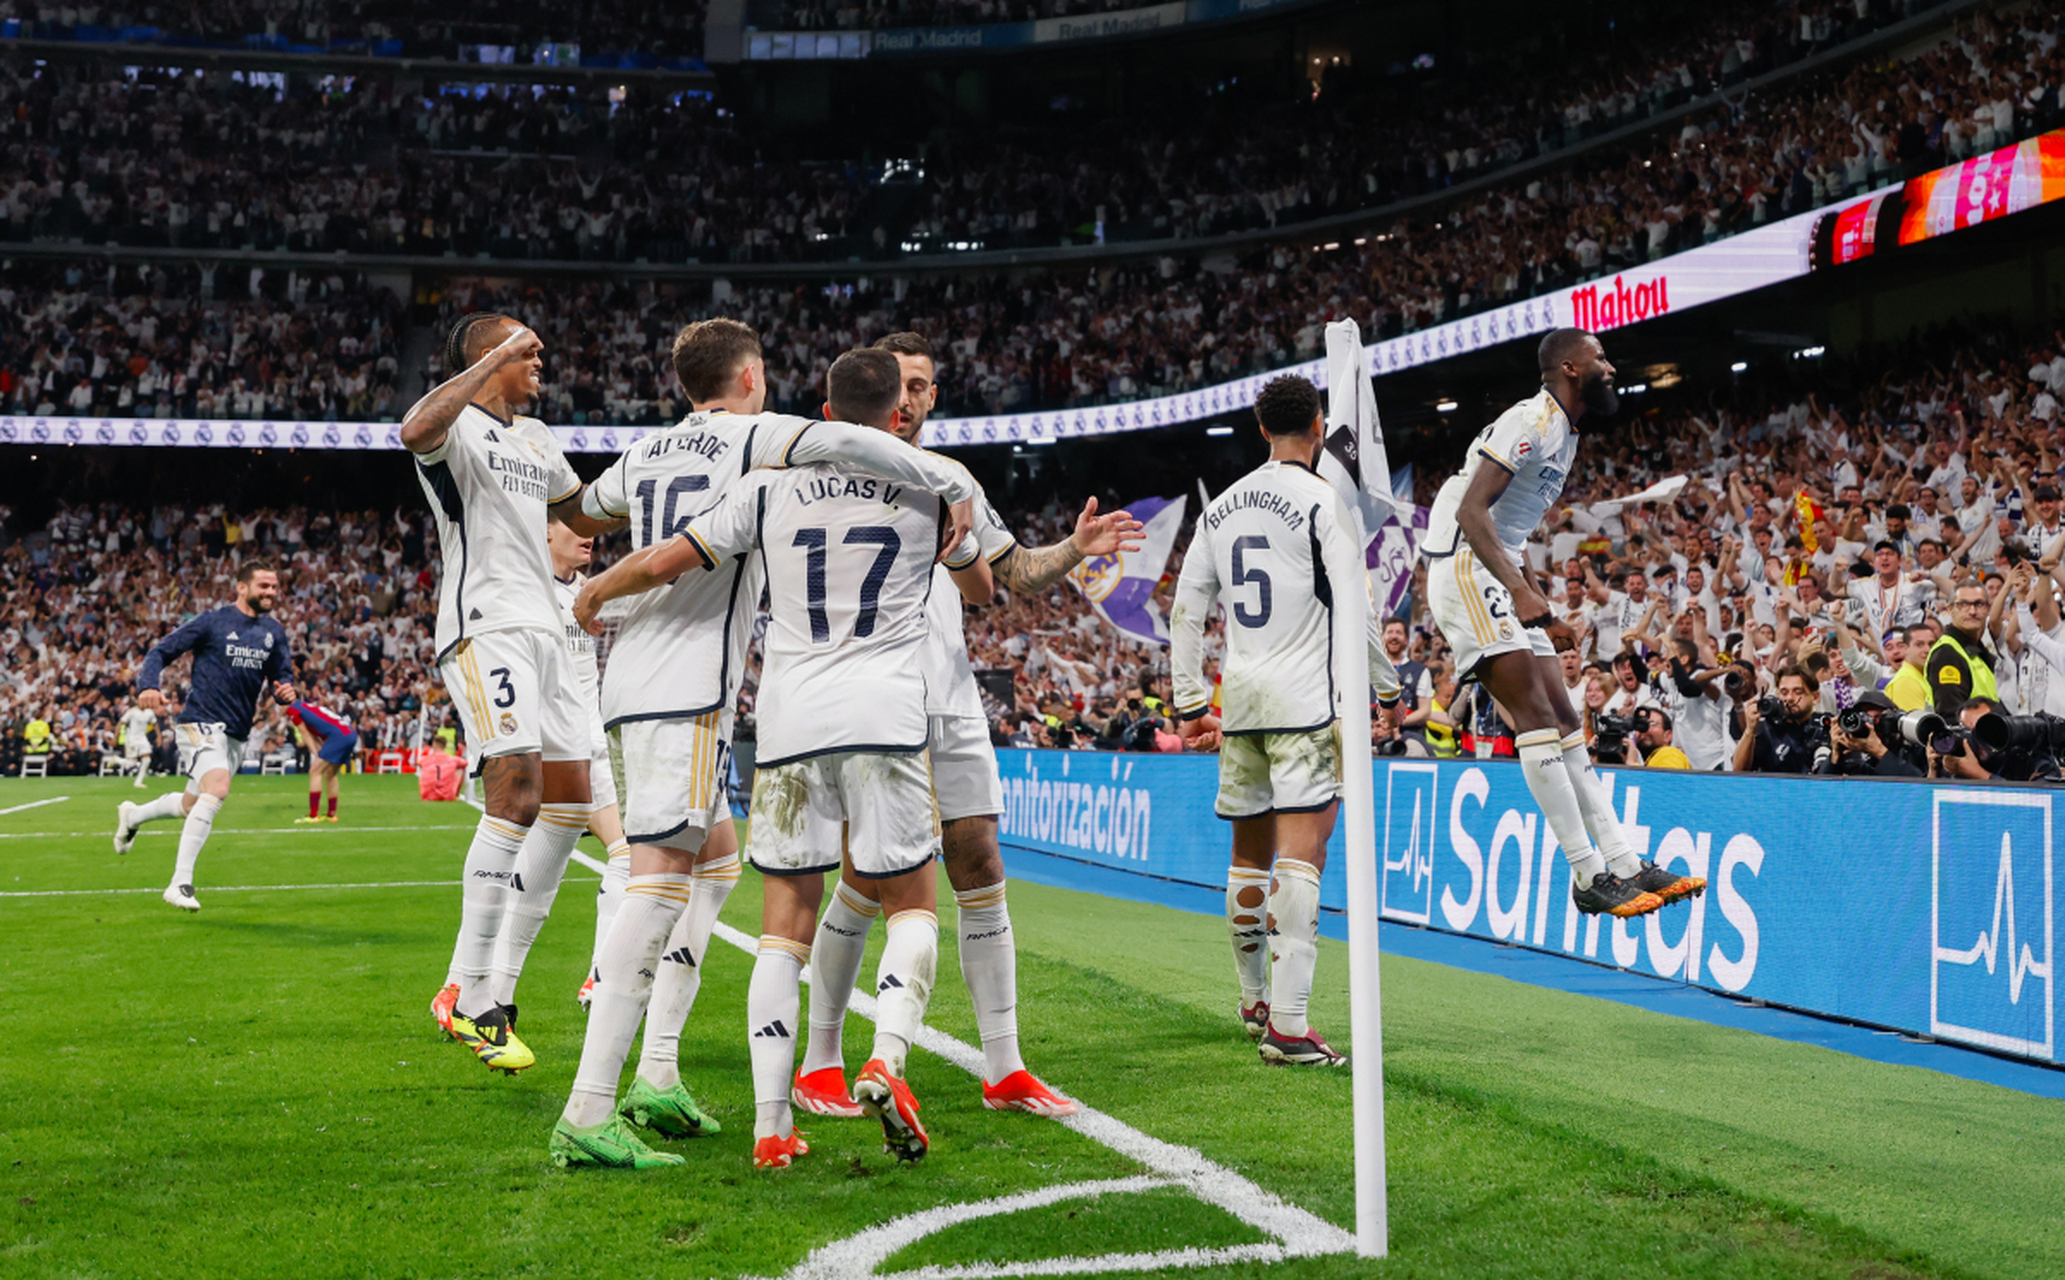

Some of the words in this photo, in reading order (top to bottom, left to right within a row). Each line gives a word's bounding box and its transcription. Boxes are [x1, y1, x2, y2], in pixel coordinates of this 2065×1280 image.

[875, 32, 913, 49] Real
[918, 30, 982, 48] Madrid
[1571, 274, 1669, 334] Mahou
[795, 477, 877, 506] LUCAS
[882, 483, 902, 510] V.
[1208, 490, 1304, 531] BELLINGHAM
[791, 526, 902, 644] 17
[1231, 535, 1272, 629] 5
[490, 667, 516, 709] 3
[434, 765, 441, 781] 1
[999, 751, 1150, 861] onitorización
